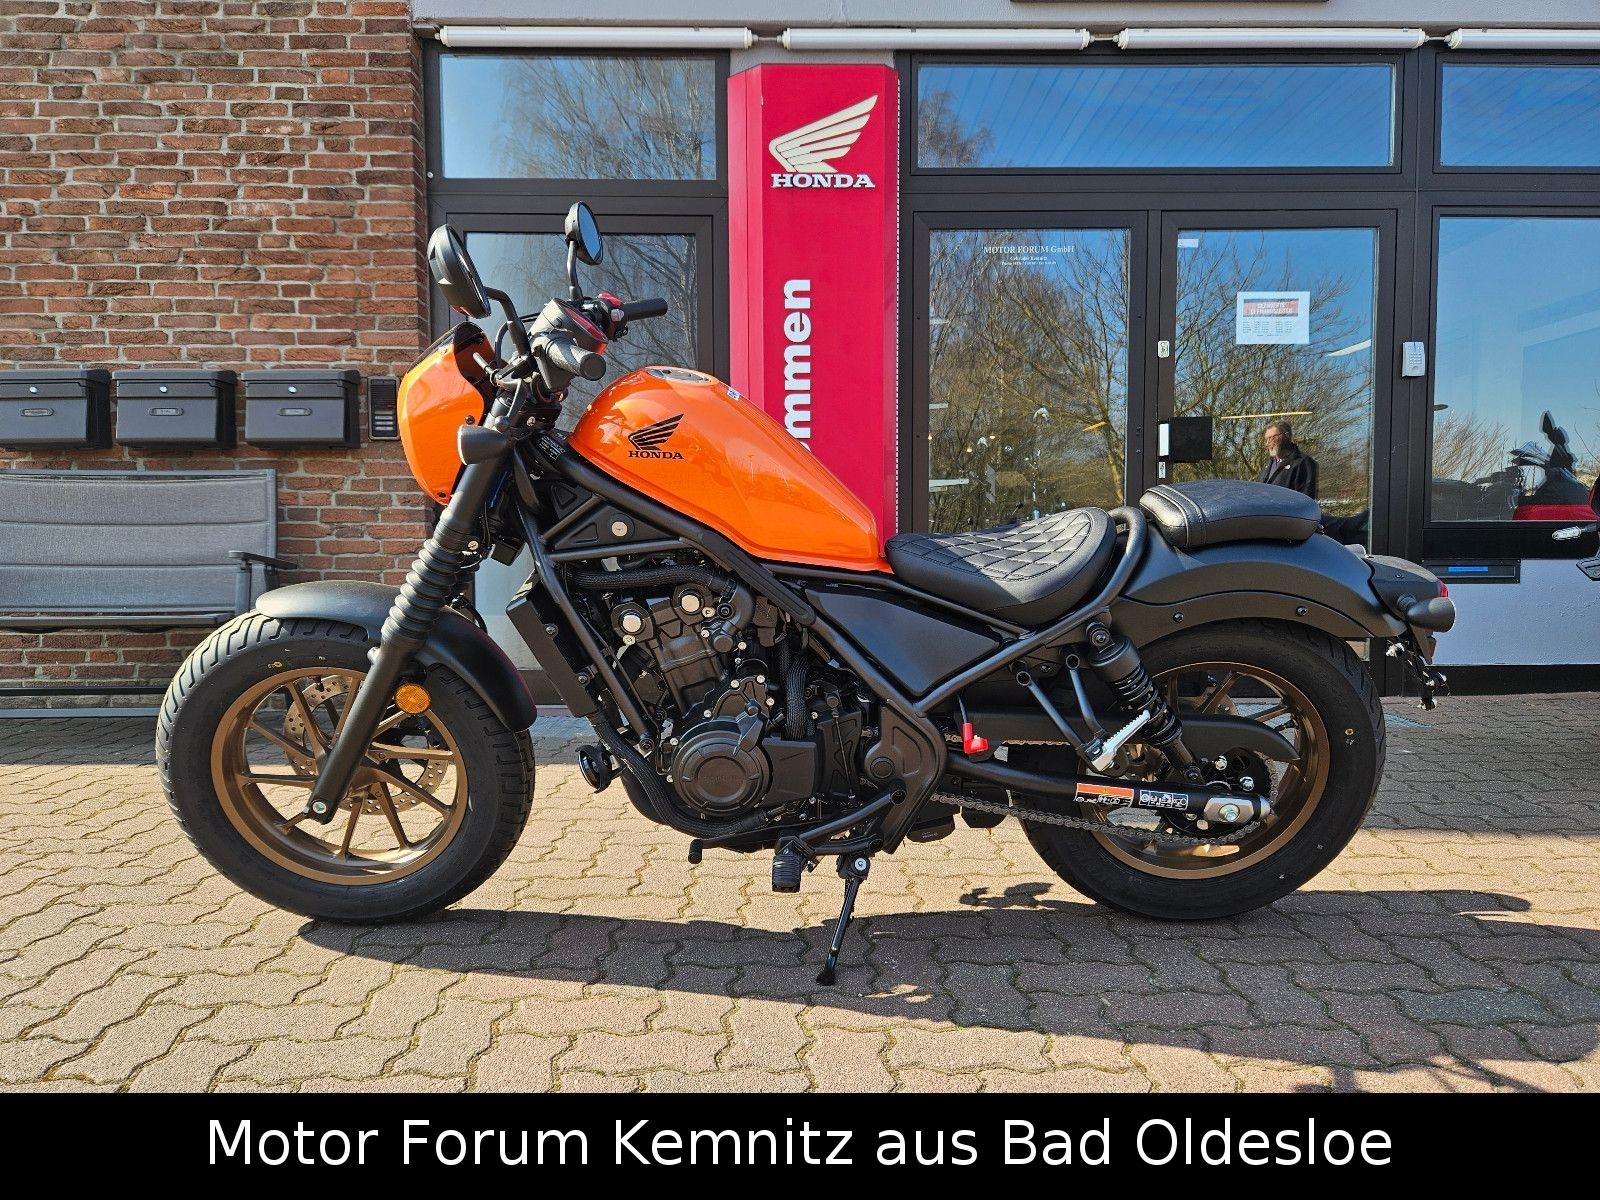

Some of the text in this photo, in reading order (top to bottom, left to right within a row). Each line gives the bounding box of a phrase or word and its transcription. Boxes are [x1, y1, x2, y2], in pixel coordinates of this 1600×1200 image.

[771, 173, 876, 189] HONDA
[983, 245, 1075, 254] MOTOR FORUM GmbH
[784, 279, 811, 452] mmen
[628, 451, 685, 460] HONDA
